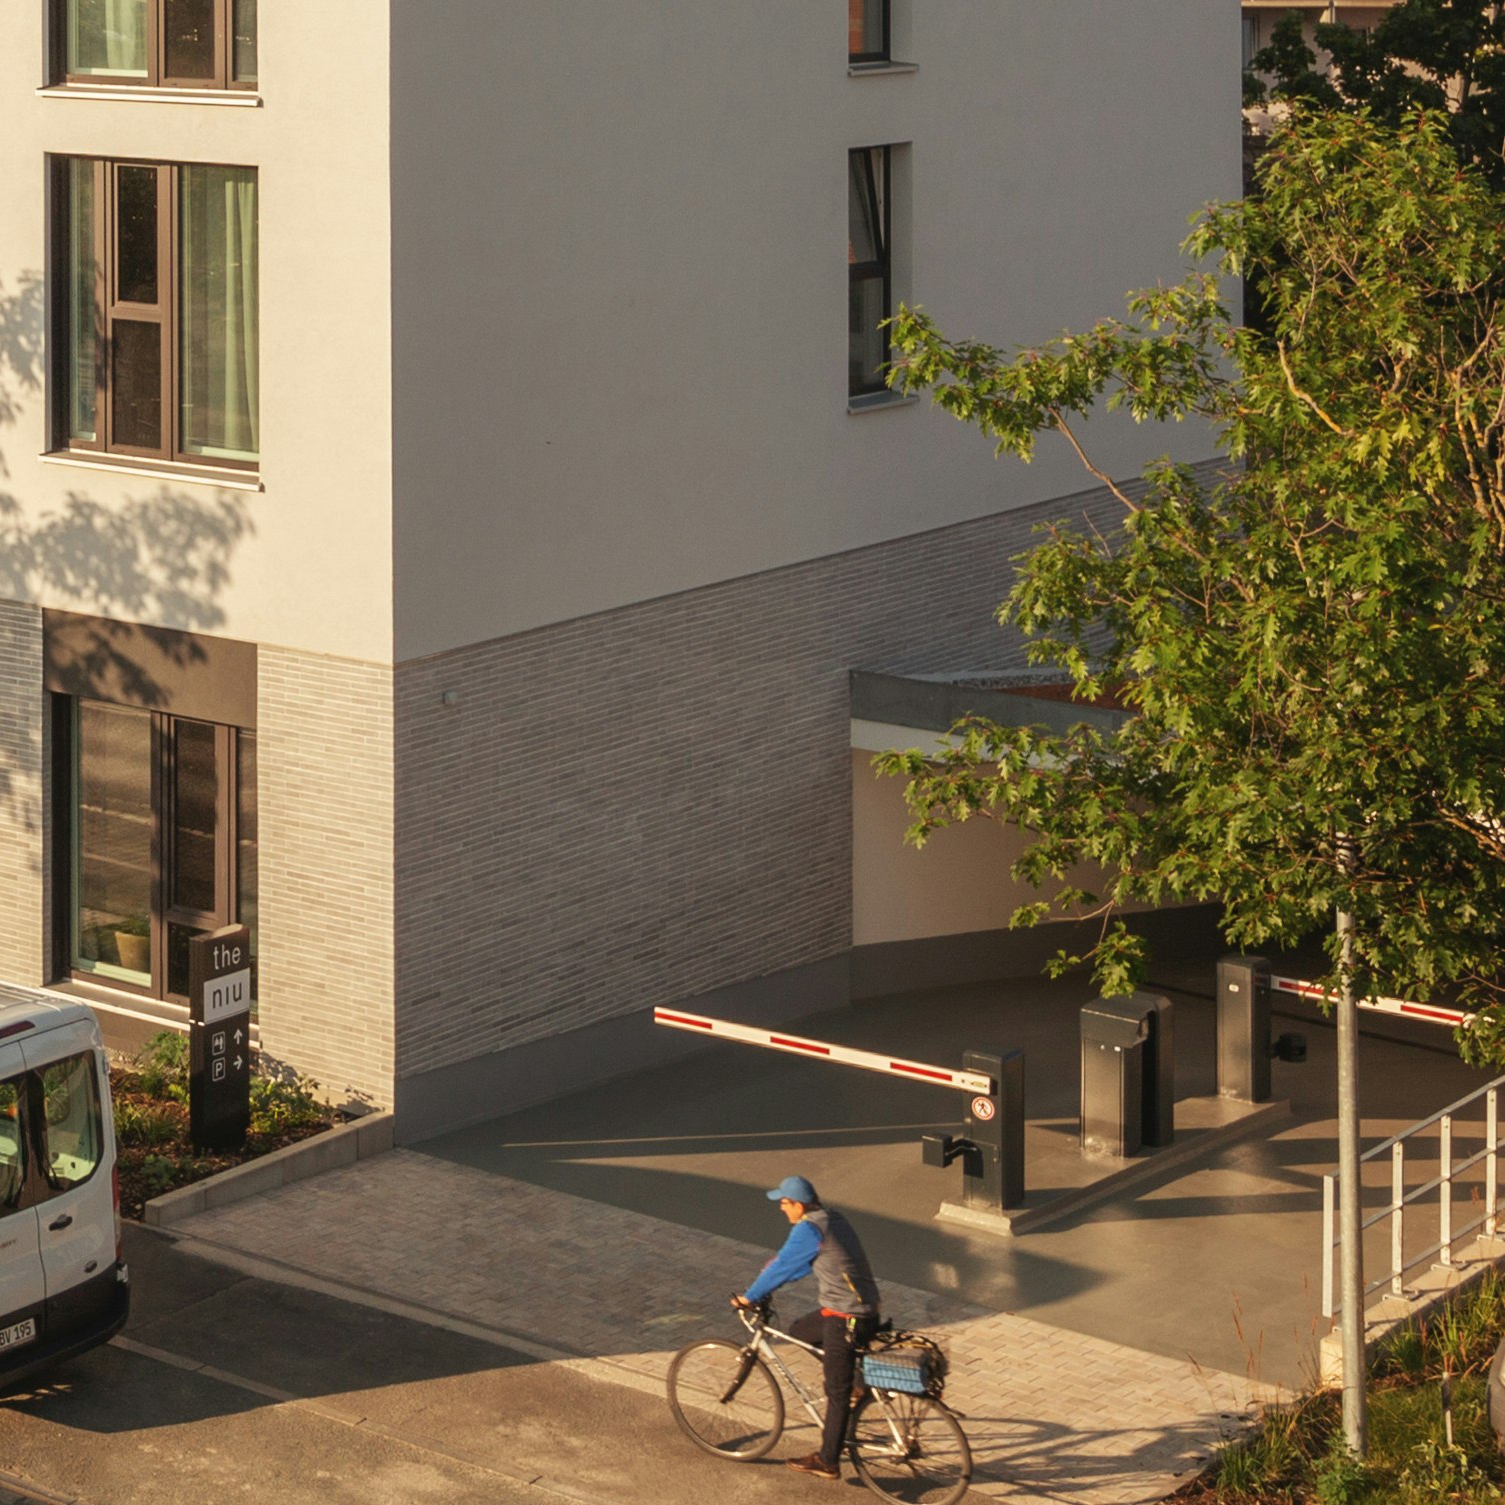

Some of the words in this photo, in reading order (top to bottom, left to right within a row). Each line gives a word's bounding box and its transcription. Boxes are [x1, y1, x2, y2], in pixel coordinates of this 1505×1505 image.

[213, 944, 241, 970] the
[212, 982, 242, 1009] niu
[13, 1321, 31, 1340] 195
